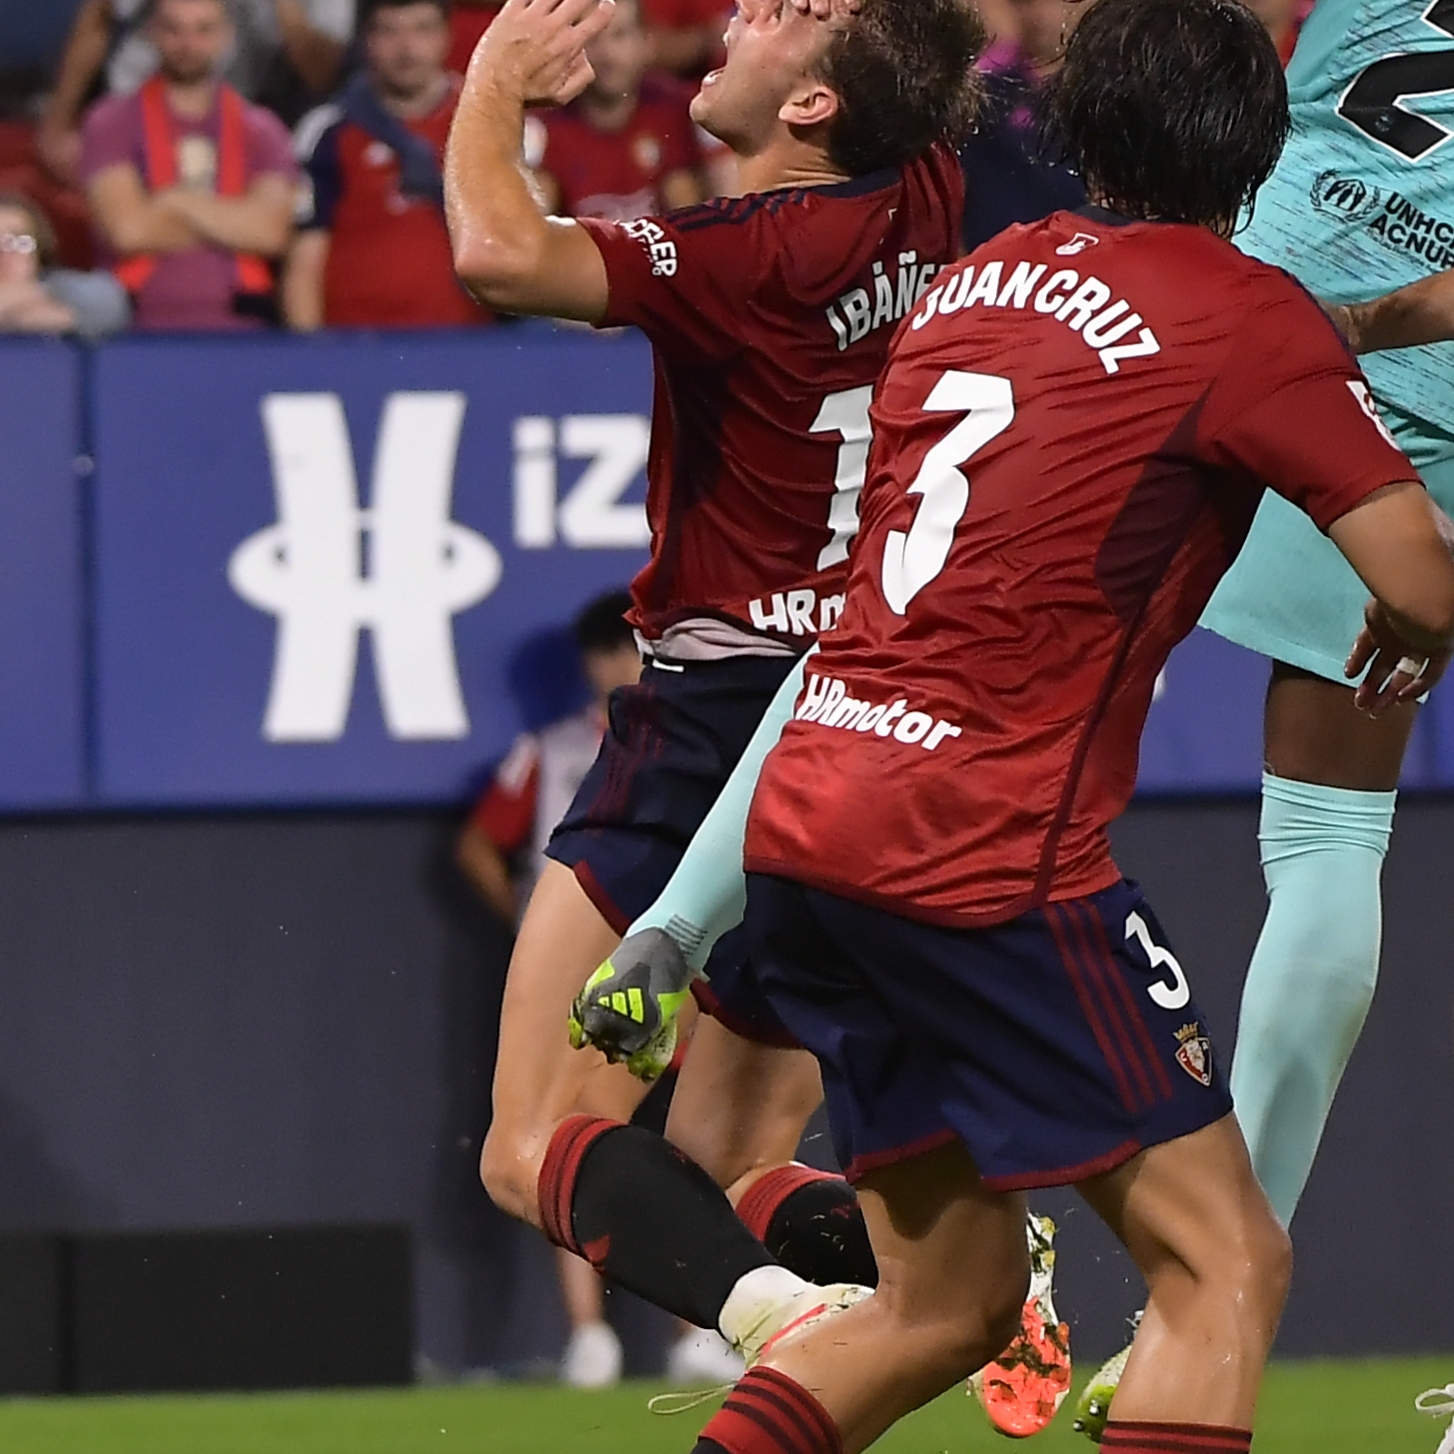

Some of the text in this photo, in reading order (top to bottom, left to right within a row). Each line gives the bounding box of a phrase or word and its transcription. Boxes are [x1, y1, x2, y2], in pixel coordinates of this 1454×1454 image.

[825, 250, 948, 352] IBÁÑE
[880, 369, 1017, 617] 3
[794, 673, 964, 751] HRmotor
[1124, 910, 1191, 1010] 3
